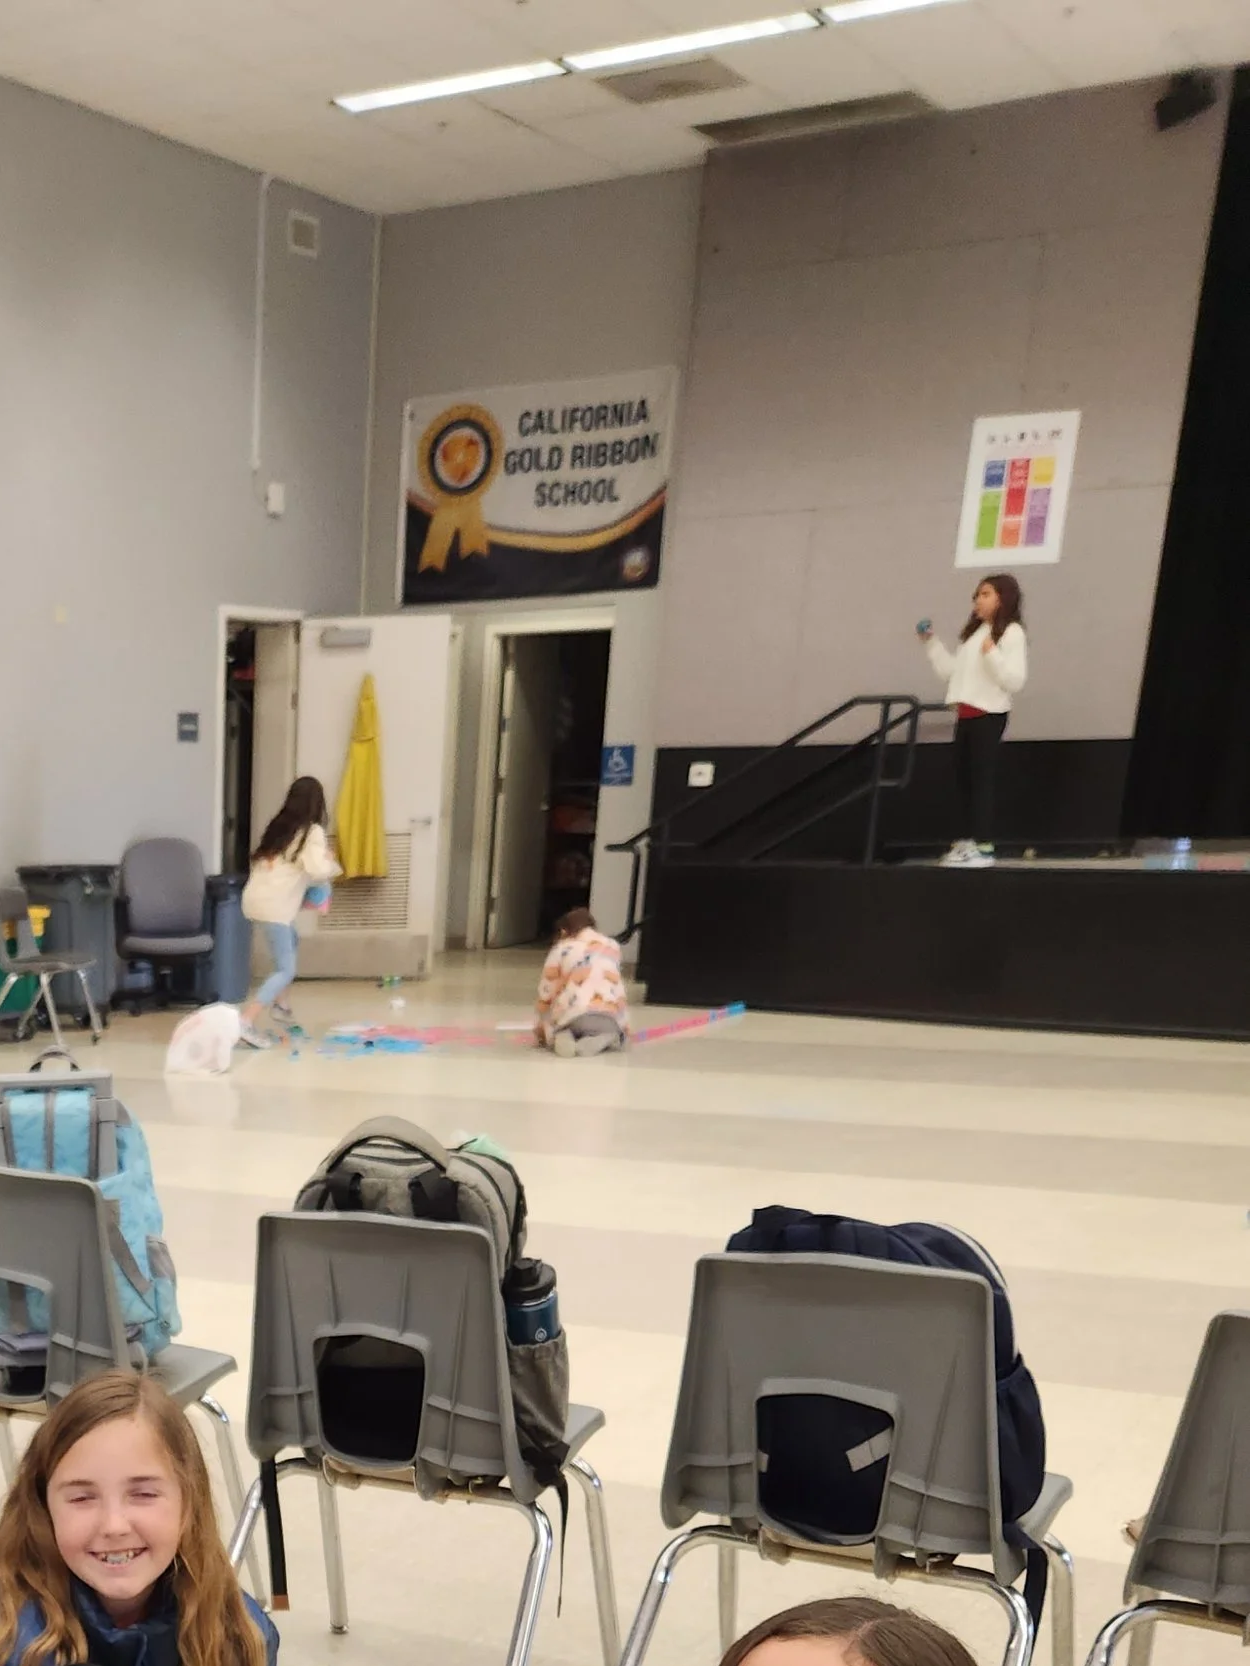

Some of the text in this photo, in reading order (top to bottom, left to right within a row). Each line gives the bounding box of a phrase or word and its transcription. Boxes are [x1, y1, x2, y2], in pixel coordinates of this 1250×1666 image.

[519, 398, 648, 437] CALIFORNIA
[504, 433, 659, 475] GOLD RIBBON
[535, 478, 618, 508] SCHOOL
